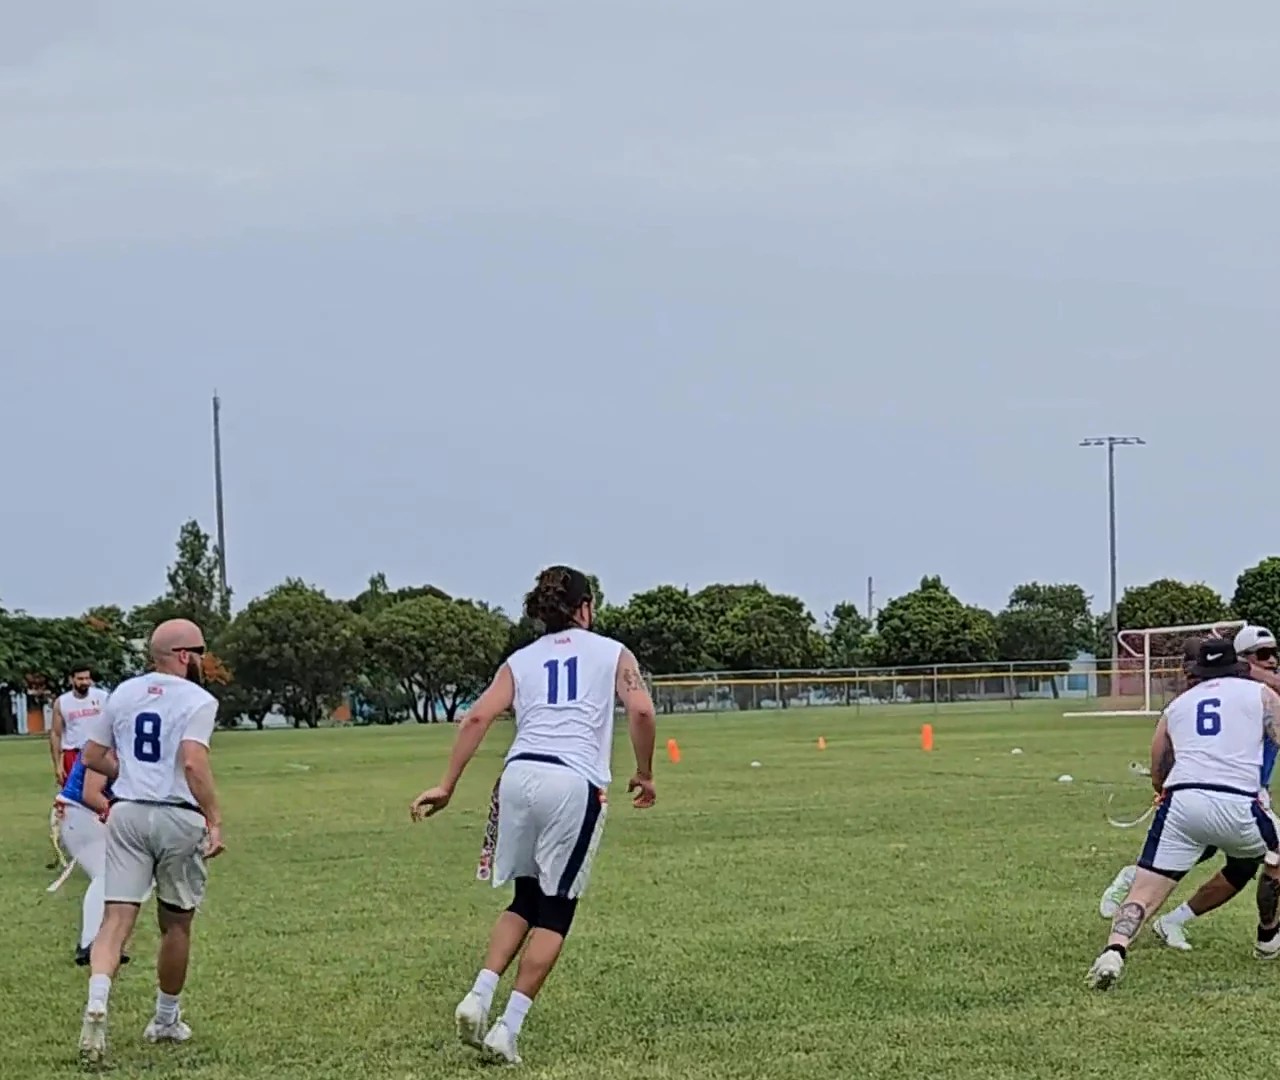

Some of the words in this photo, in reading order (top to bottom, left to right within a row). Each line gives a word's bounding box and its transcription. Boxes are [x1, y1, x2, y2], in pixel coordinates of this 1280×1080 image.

[543, 656, 578, 705] 11
[134, 712, 162, 763] 8
[1196, 698, 1222, 736] 6
